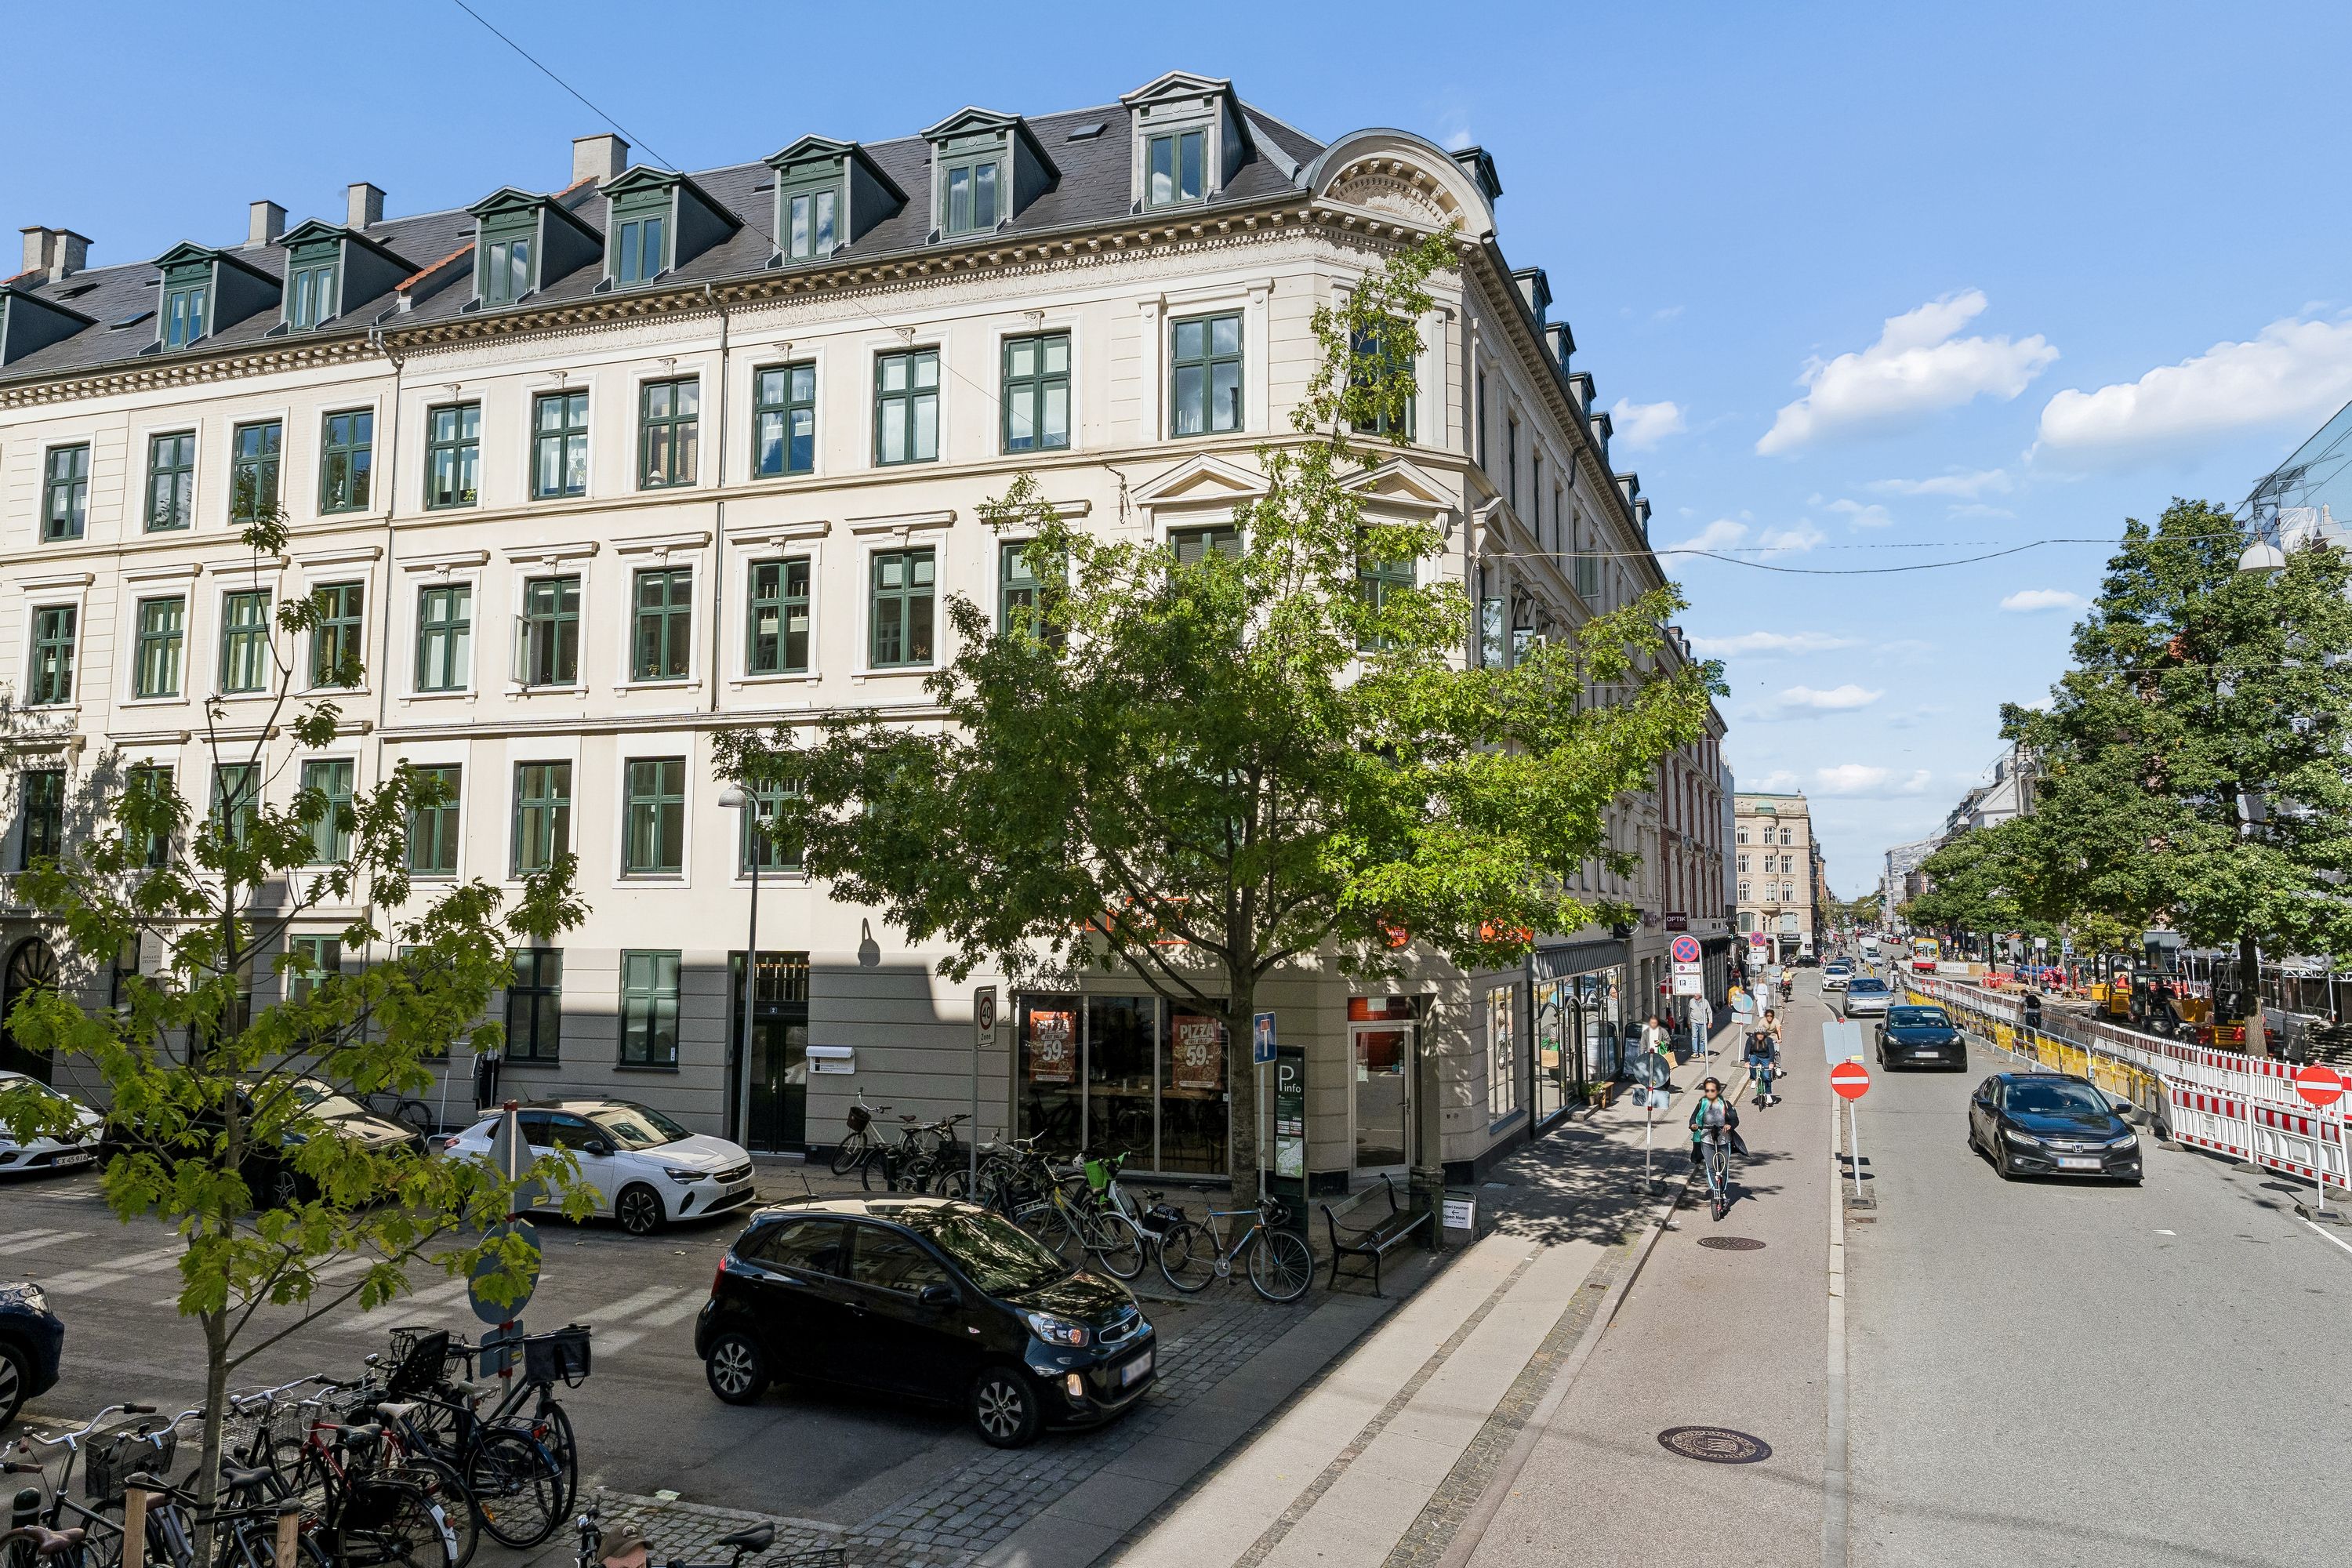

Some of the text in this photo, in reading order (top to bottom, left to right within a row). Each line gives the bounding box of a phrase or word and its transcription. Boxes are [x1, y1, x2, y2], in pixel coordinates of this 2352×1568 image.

[982, 1007, 990, 1019] 40
[1037, 1019, 1069, 1035] PIZZA
[1180, 1023, 1214, 1039] PIZZA
[1042, 1040, 1069, 1062] 59.-
[1185, 1044, 1214, 1066] 59.-
[1279, 1065, 1294, 1092] P
[1284, 1083, 1301, 1093] info
